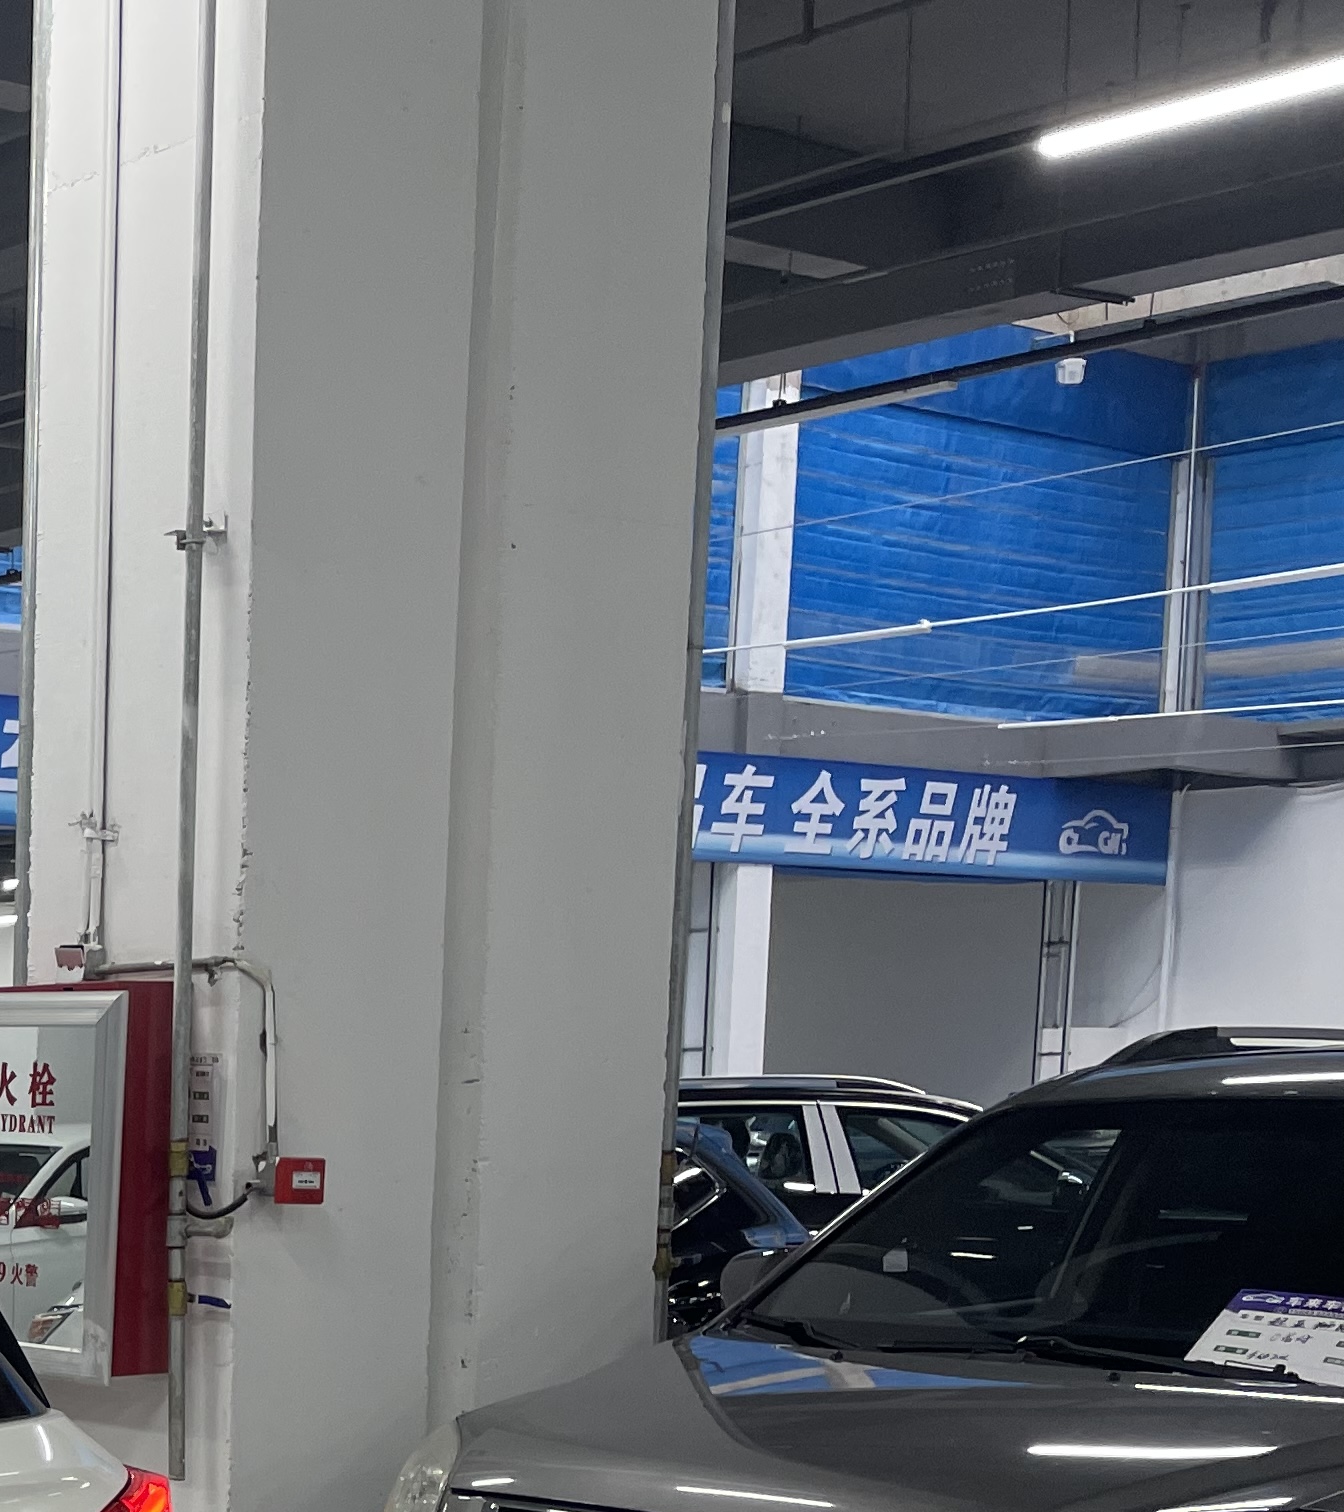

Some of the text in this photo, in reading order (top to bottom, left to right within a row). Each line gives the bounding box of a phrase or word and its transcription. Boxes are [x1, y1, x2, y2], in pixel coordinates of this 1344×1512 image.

[691, 764, 1018, 866] 车 全系品牌
[10, 1263, 39, 1287] 火警
